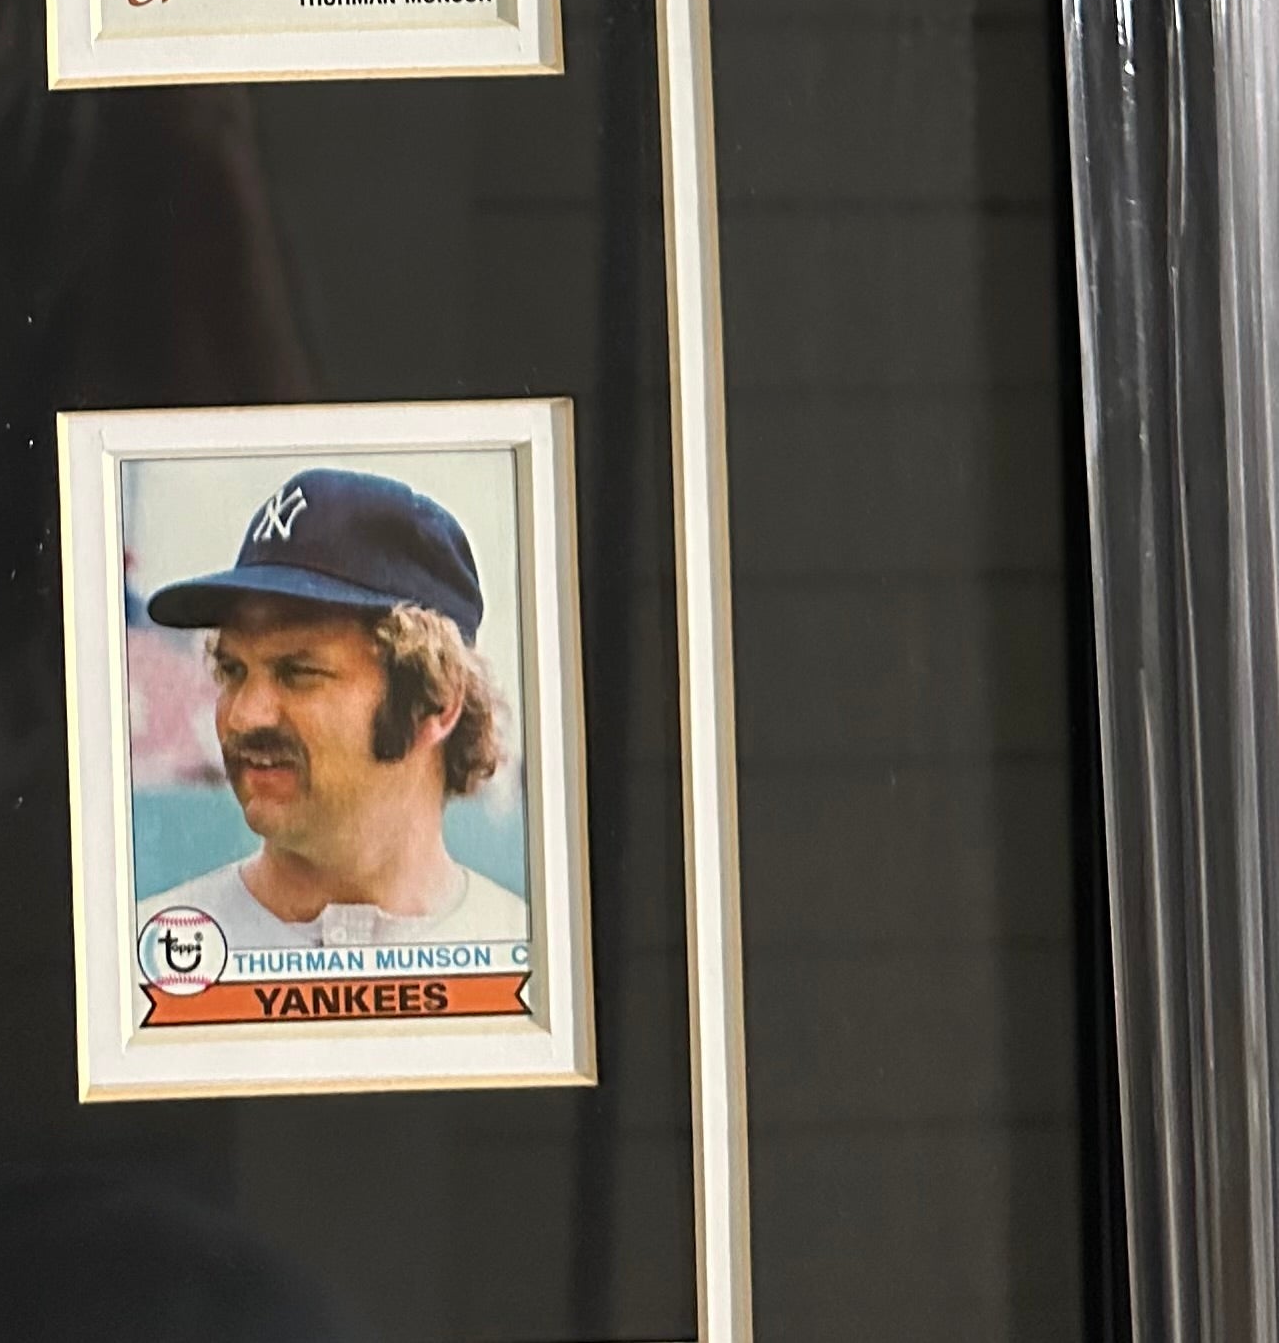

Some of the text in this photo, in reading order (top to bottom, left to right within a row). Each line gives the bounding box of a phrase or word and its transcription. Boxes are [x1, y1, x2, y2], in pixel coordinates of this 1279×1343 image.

[232, 949, 364, 974] THURMAN
[376, 944, 492, 969] MUNSON
[254, 981, 449, 1016] YANKEES
